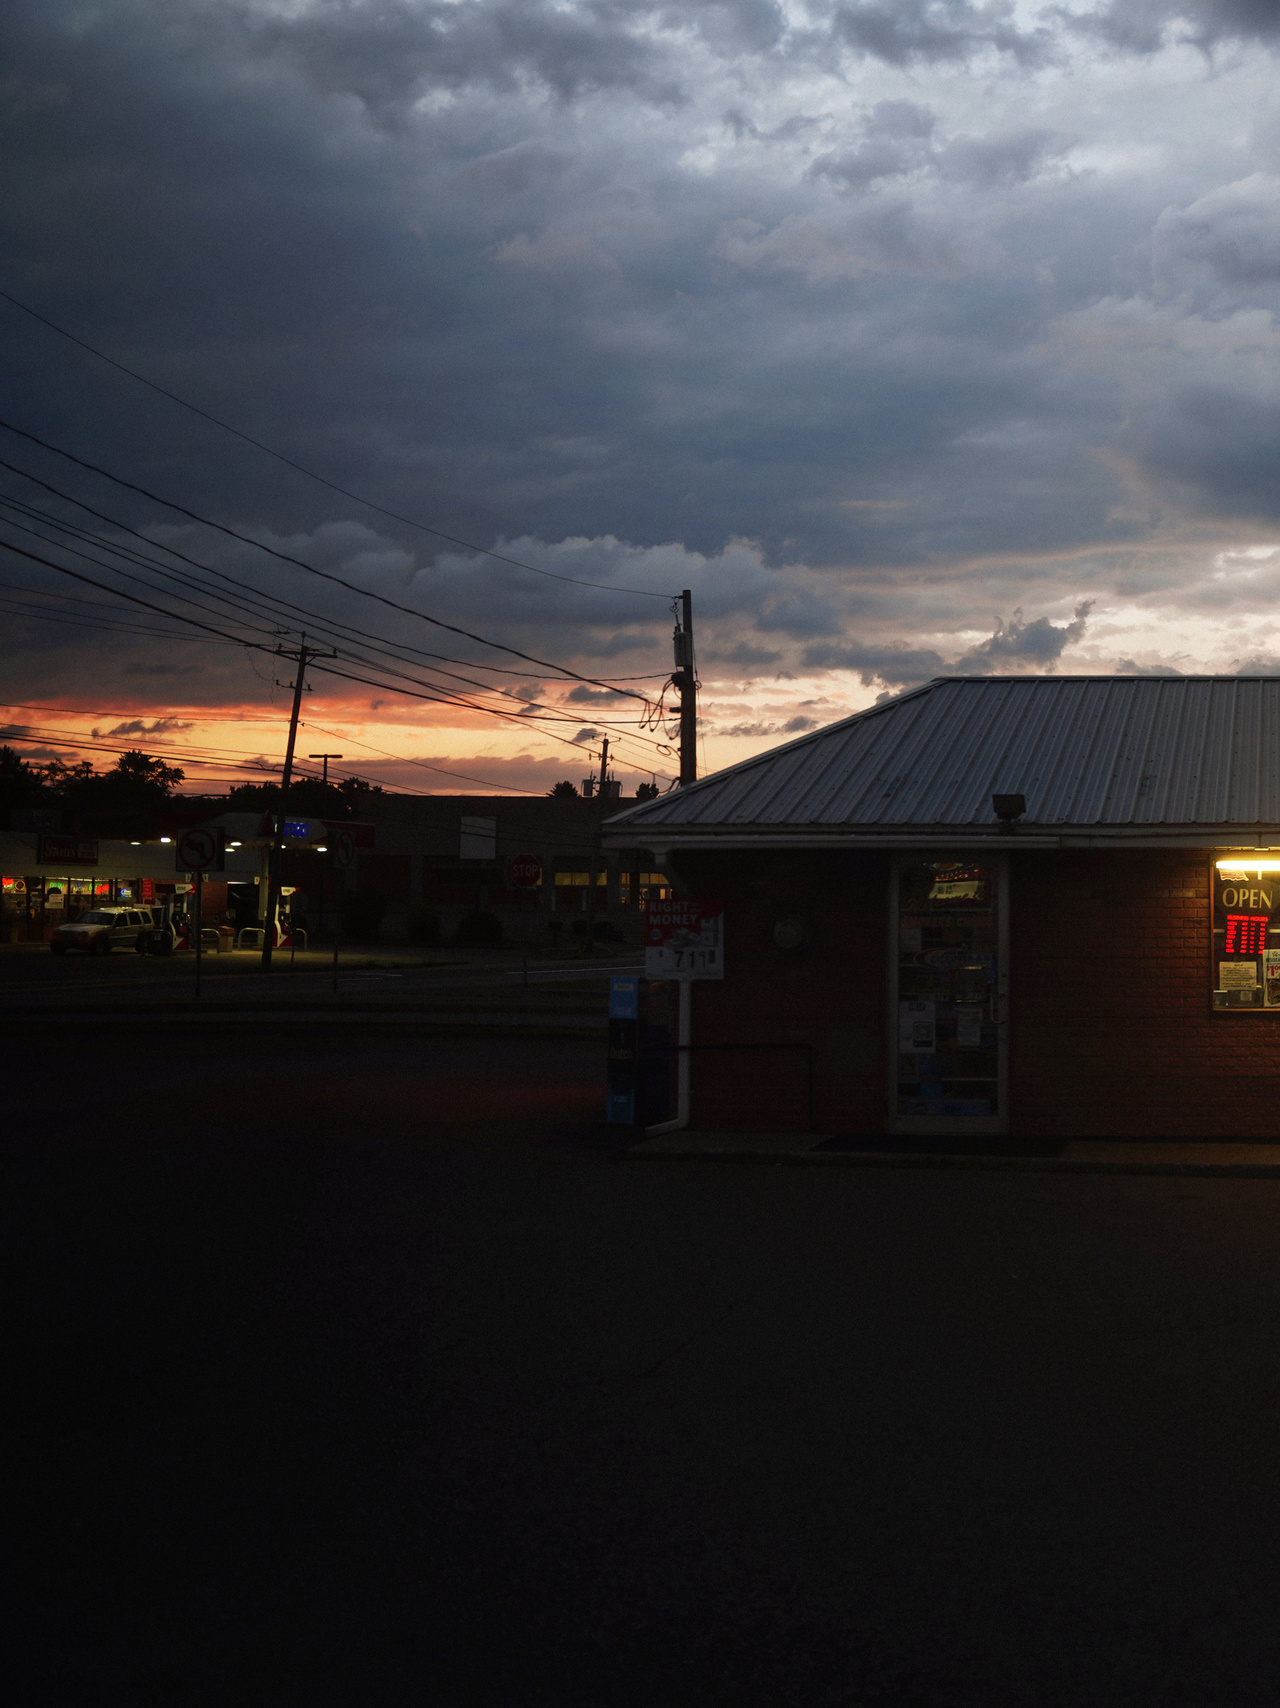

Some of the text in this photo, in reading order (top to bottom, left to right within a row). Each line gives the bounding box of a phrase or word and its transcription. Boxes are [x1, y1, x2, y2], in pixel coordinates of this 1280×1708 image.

[512, 864, 539, 878] STOP
[1222, 887, 1272, 909] OPEN
[649, 901, 689, 913] RIGHT
[649, 914, 698, 925] MONEY
